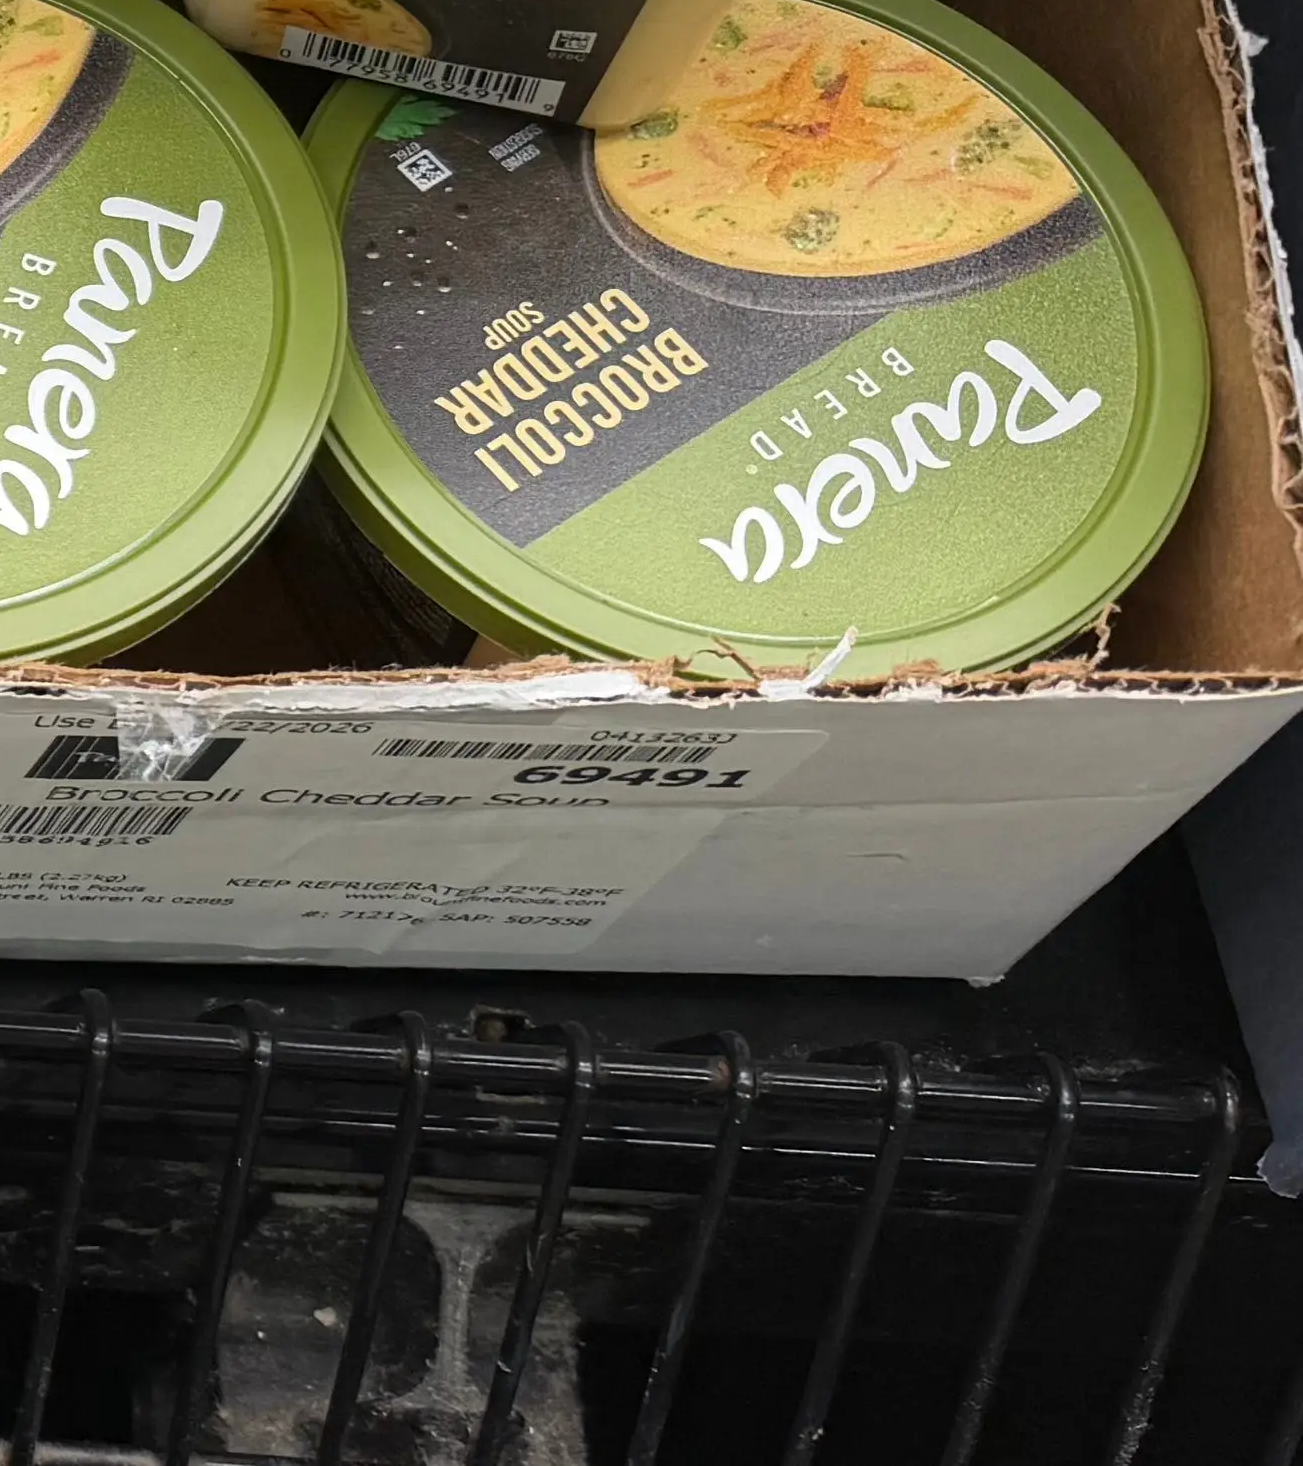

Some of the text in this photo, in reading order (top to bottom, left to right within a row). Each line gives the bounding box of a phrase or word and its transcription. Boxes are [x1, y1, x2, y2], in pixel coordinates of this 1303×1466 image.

[489, 123, 544, 160] SUGGESTION
[501, 143, 540, 173] SERVING
[485, 300, 545, 352] SOUP
[434, 287, 651, 437] CHEDDAR
[473, 327, 708, 493] BROCCOLI
[698, 339, 1102, 584] Panera
[34, 714, 94, 729] Use
[513, 765, 752, 789] 69491
[45, 786, 244, 805] Broccoli
[260, 788, 472, 807] Cheddar
[225, 877, 491, 897] KEEP REFRIGERATED
